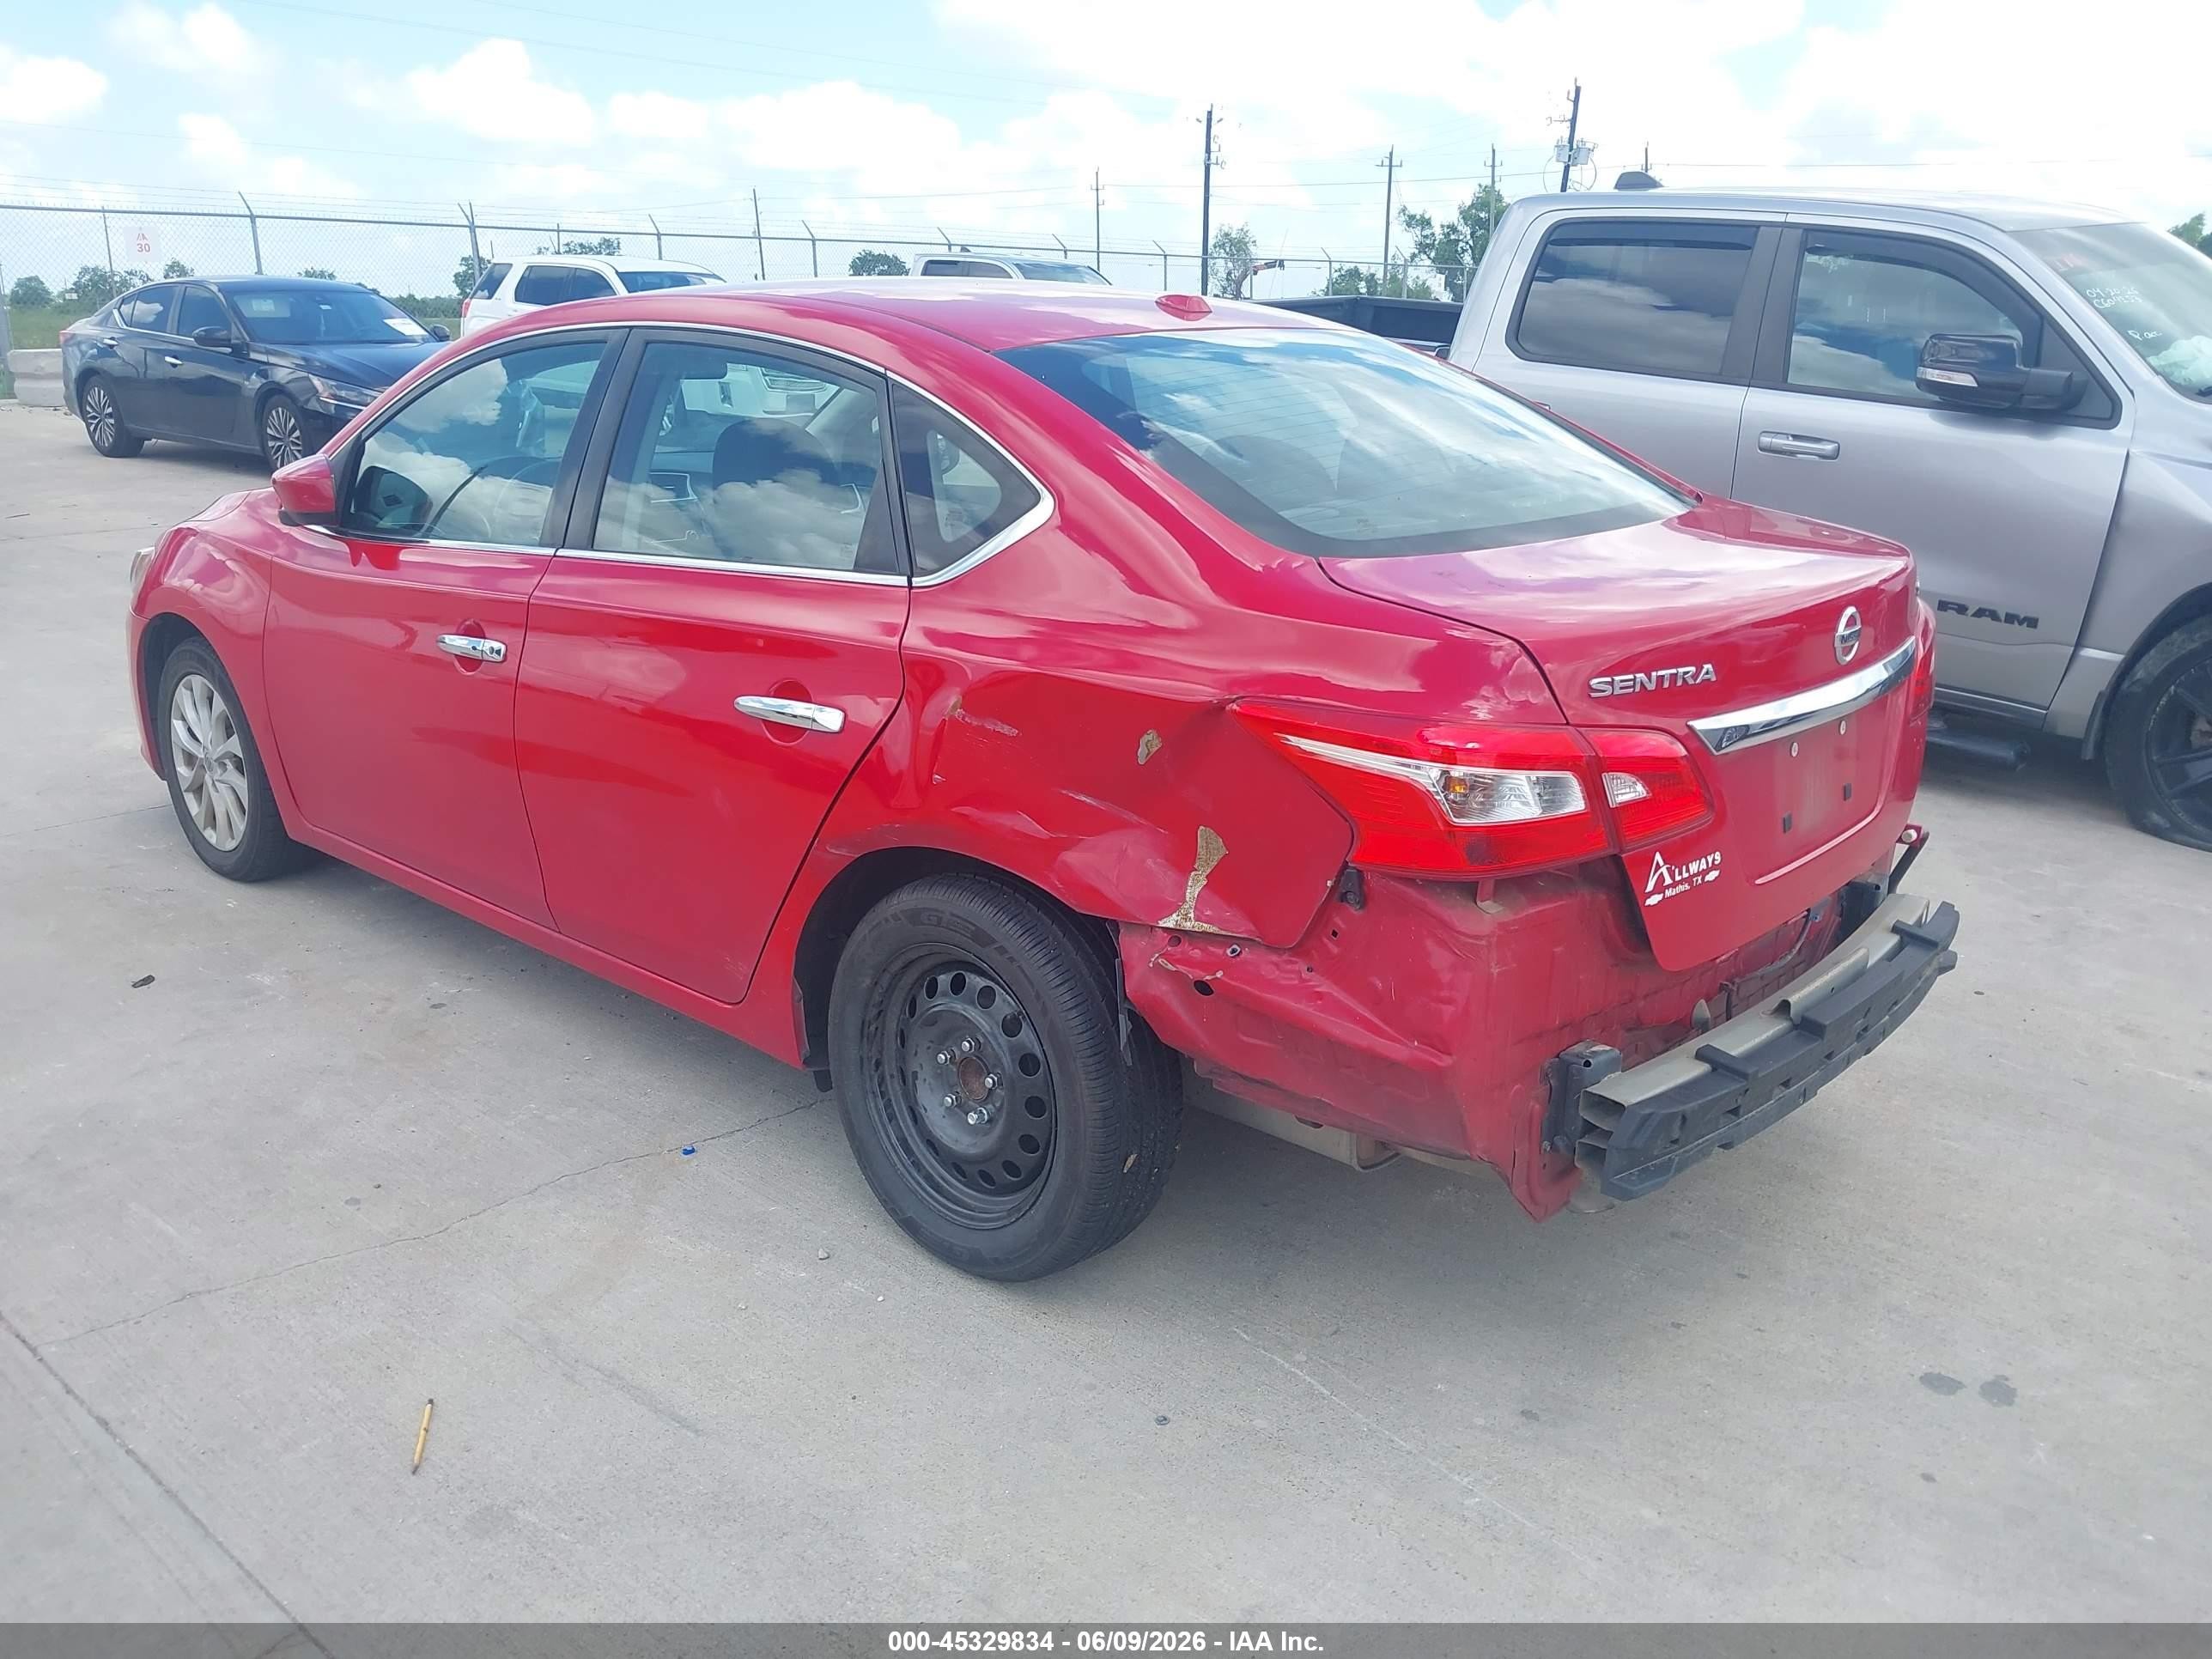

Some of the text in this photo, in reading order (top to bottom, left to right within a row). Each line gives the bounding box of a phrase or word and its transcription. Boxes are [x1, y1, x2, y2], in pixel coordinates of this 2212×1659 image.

[137, 243, 151, 252] 30
[1936, 599, 2039, 629] RAM
[1588, 663, 1717, 698] SENTRA
[1692, 875, 1703, 887] TX
